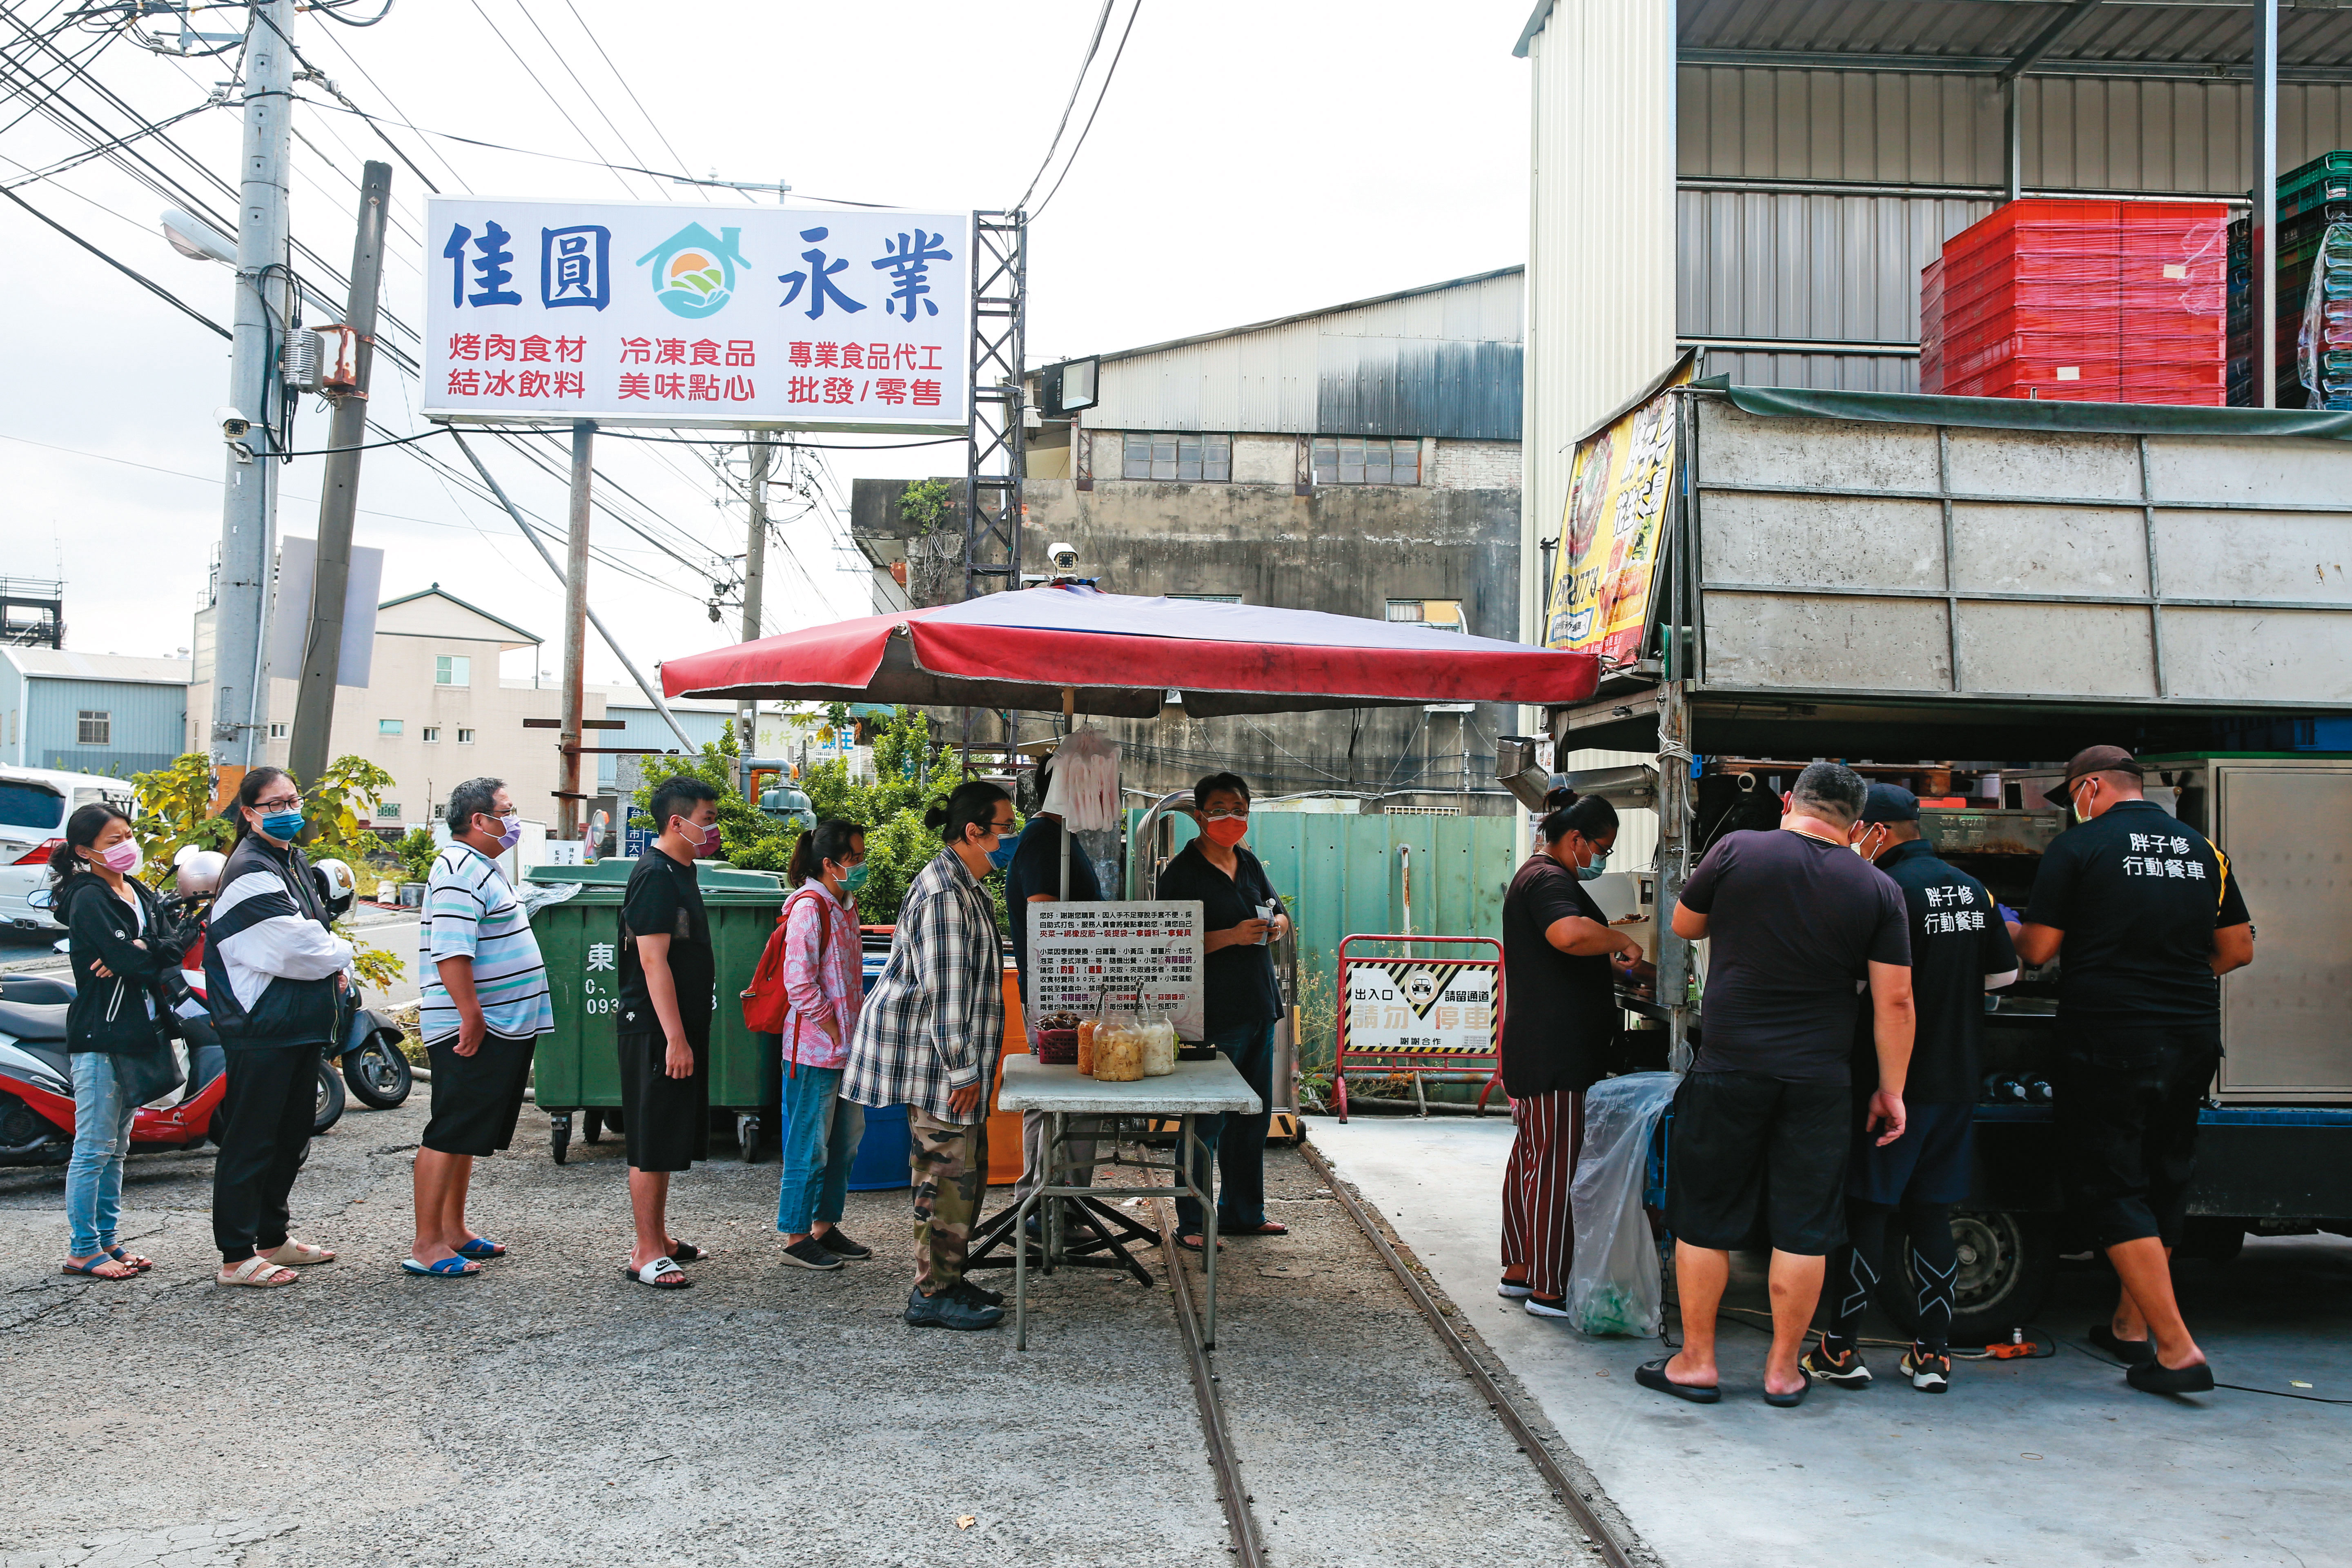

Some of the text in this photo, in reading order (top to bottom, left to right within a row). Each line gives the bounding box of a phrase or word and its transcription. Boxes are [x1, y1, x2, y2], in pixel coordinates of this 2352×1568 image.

[443, 220, 953, 324] 佳圓 永業
[448, 334, 587, 364] 烤肉食材
[619, 336, 755, 368] 冷凍食品
[787, 341, 943, 372] 專業食品代工
[447, 369, 586, 400] 結冰飲料
[618, 372, 755, 403] 美味點心
[787, 376, 942, 407] 批發/零售
[2129, 833, 2190, 855] 胖子修
[2122, 855, 2206, 880] 行動餐車
[1924, 885, 1974, 907] 胖子修
[1924, 910, 1985, 934] 行動餐車
[586, 942, 616, 972] 東
[1354, 989, 1393, 1001] 出入口
[1444, 990, 1490, 1002] 請留通道
[1352, 1004, 1490, 1030] 請勿 停車
[1400, 1037, 1441, 1046] 謝謝合作
